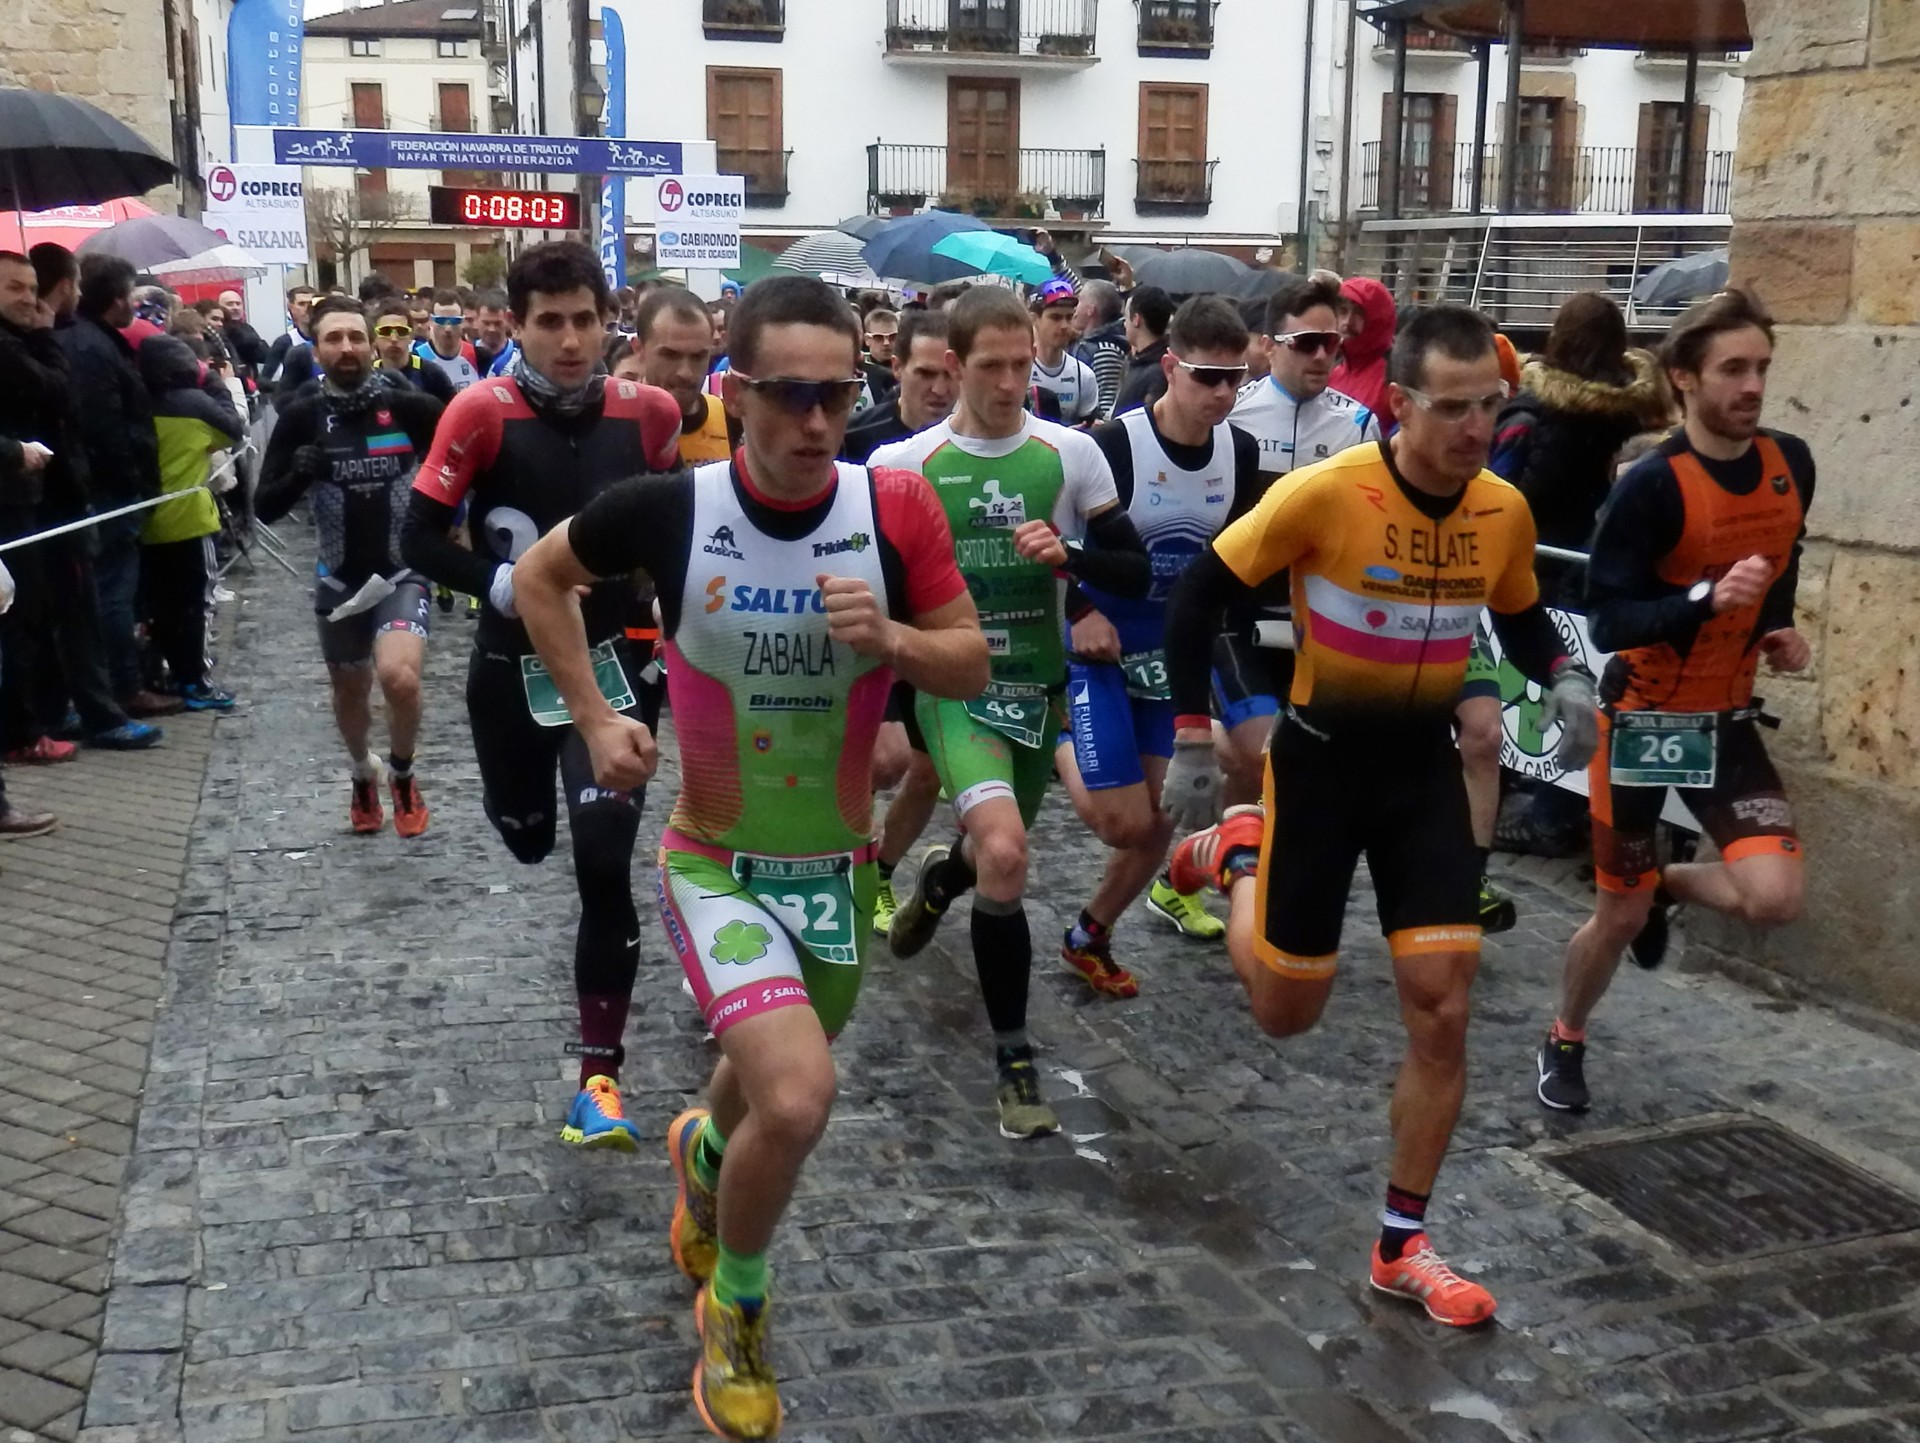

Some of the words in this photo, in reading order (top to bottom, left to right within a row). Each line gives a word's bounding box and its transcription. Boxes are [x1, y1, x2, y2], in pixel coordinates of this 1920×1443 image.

[390, 139, 459, 152] FEDERACIÓN
[461, 142, 511, 153] NAVARRA
[513, 144, 528, 154] DE
[529, 143, 579, 155] TRIATLÓN
[397, 152, 438, 162] NAFAR
[442, 153, 496, 163] TRIATLOI
[499, 155, 573, 166] FEDERAZIOA
[241, 181, 302, 197] COPRECI
[245, 199, 300, 209] ALTSASUKO
[687, 192, 742, 207] COPRECI
[464, 194, 564, 223] 0:08:03
[690, 209, 738, 219] ALTSASUKO
[237, 230, 305, 249] SAKANA
[680, 232, 738, 247] GABIRONDO
[659, 248, 696, 259] VEHICULOS
[697, 249, 707, 259] DE
[708, 249, 738, 259] OCASION
[332, 455, 401, 481] ZAPATERIA
[743, 631, 835, 676] ZABALA
[749, 694, 833, 709] Bianchi
[986, 701, 1025, 720] 46
[1080, 705, 1100, 772] FUMBARRI
[1639, 735, 1684, 763] 26
